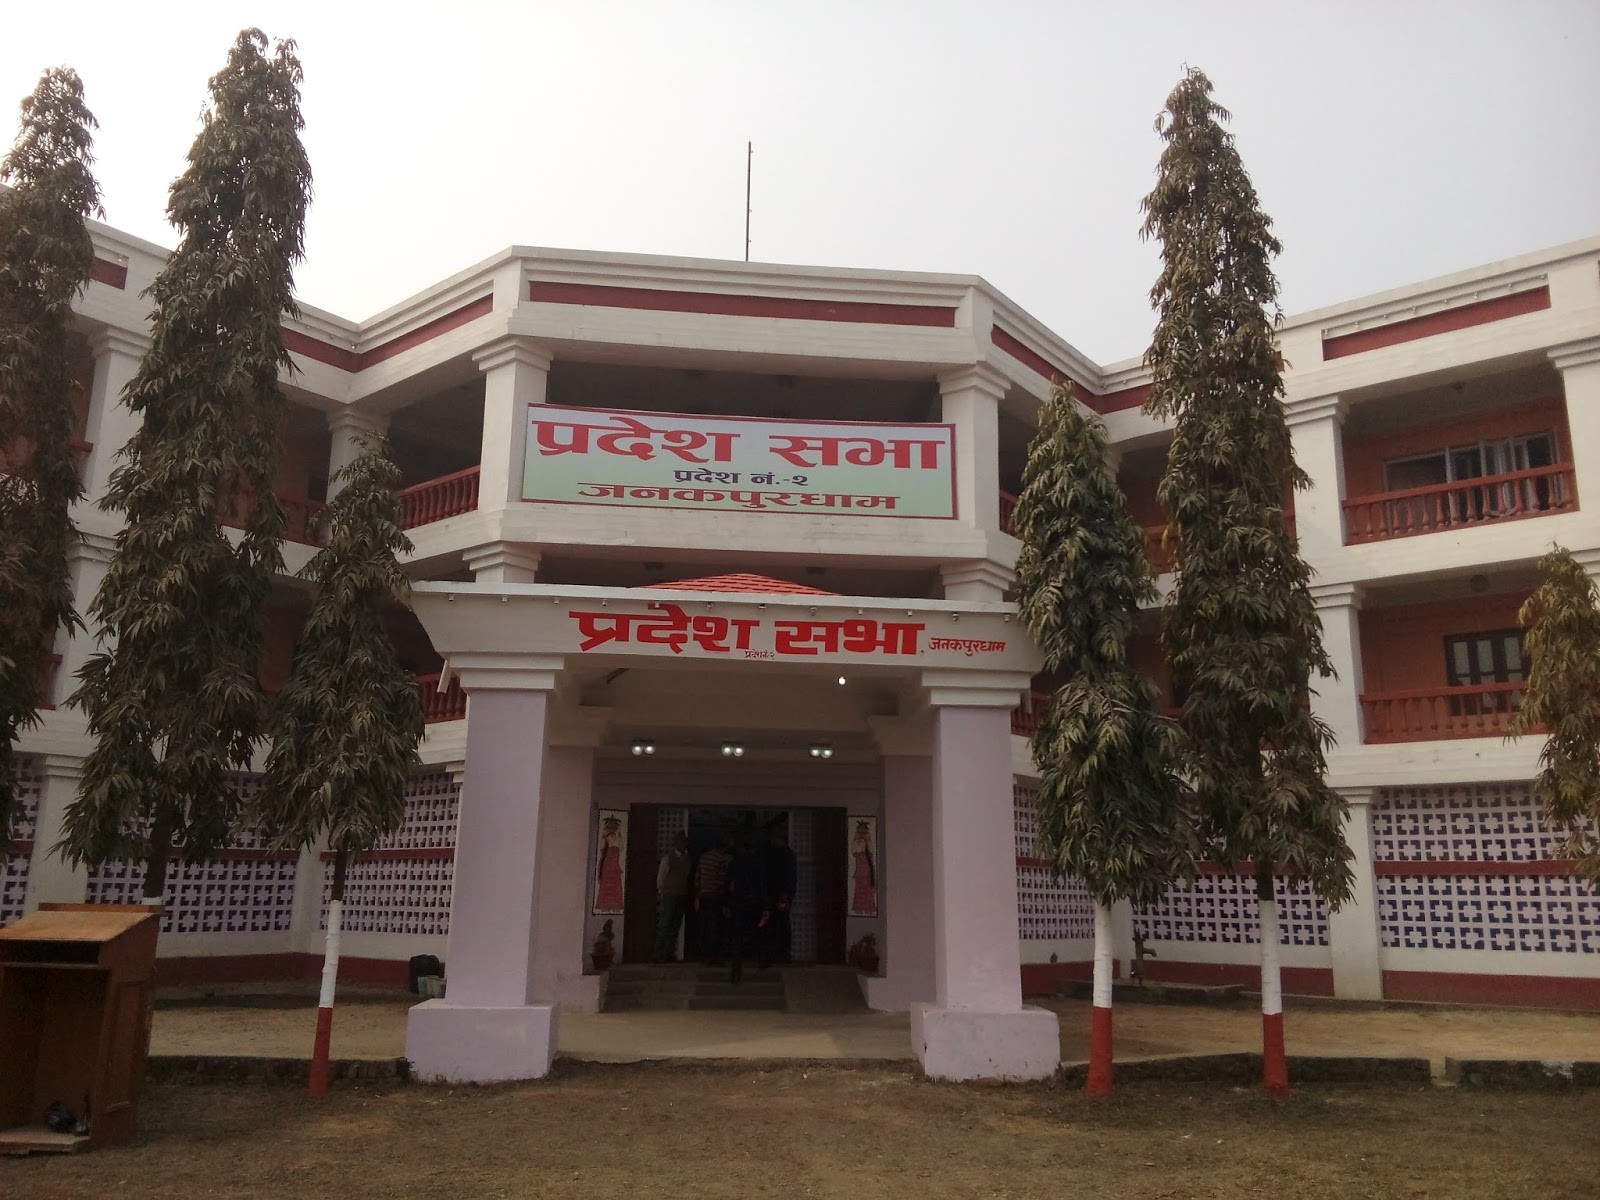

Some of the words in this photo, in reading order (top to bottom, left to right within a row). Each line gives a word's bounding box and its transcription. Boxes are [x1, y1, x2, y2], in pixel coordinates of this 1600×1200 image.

[532, 416, 740, 463] प्रदेश
[769, 433, 945, 469] सभा
[673, 467, 741, 484] प्रदेश
[577, 482, 901, 510] जनकपुरधाम
[568, 603, 760, 653] प्रदेश
